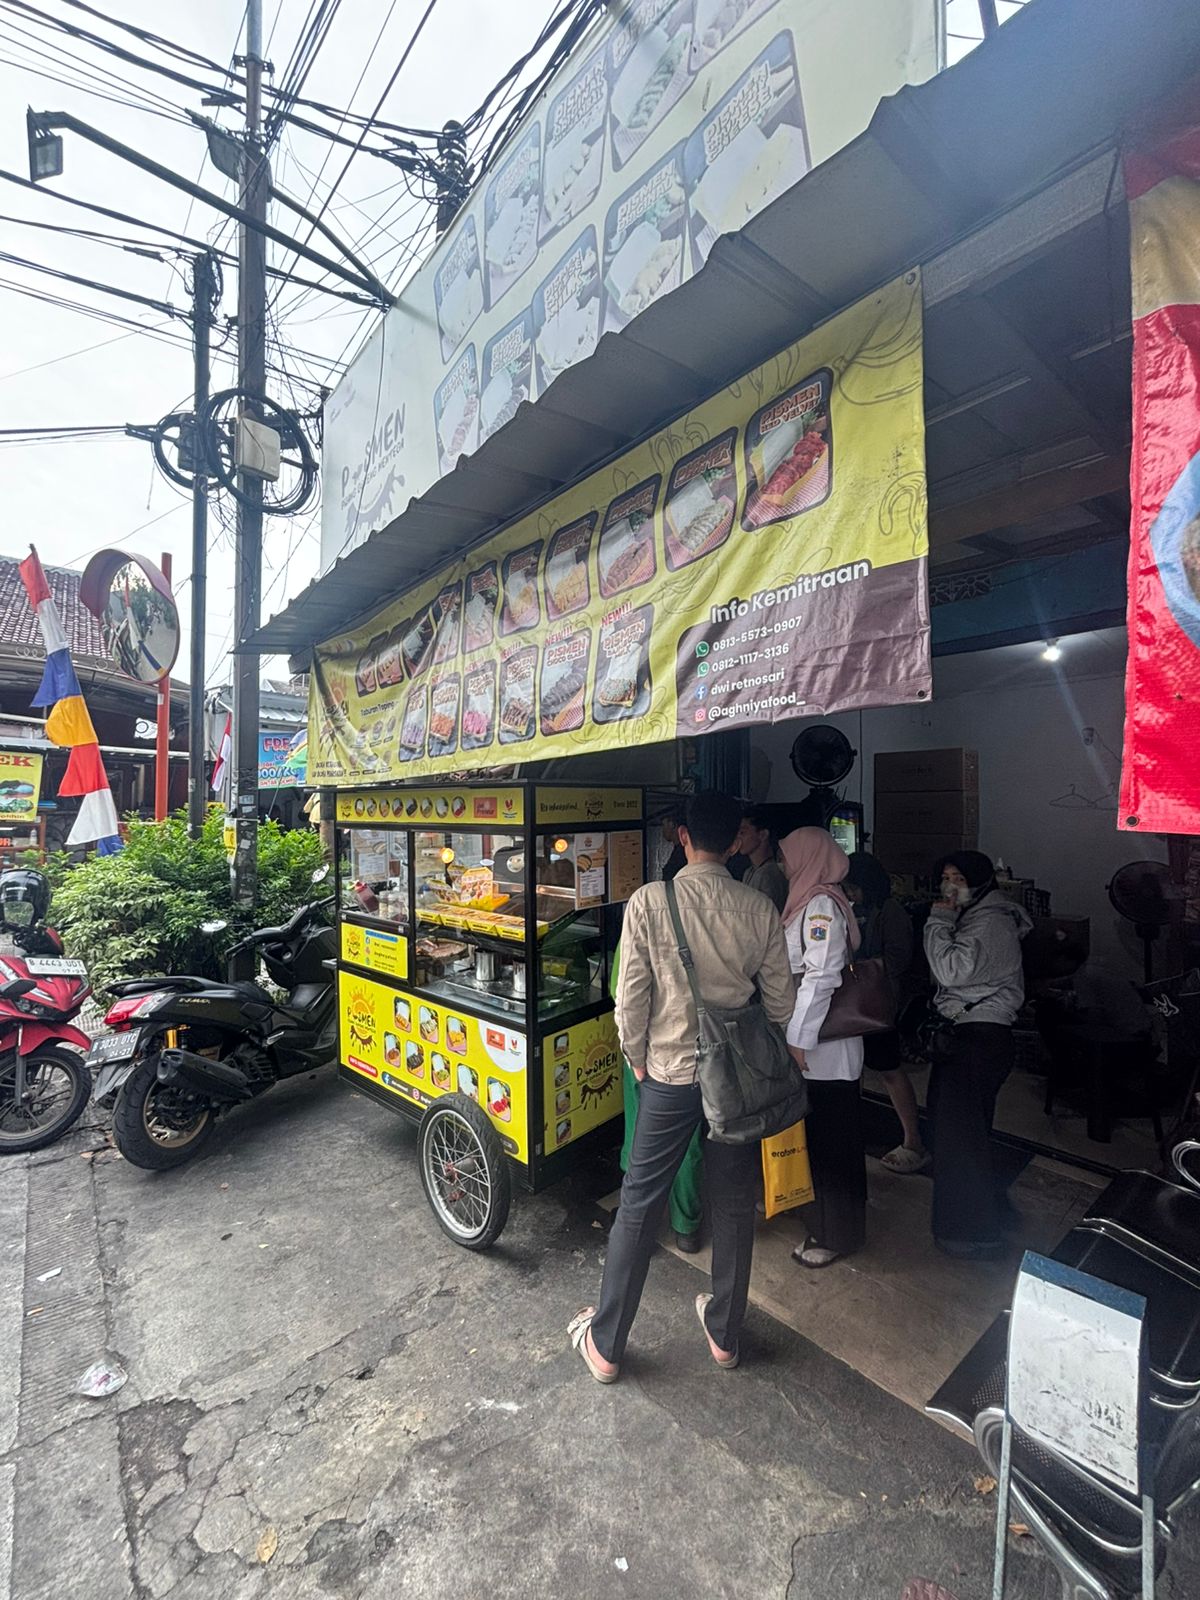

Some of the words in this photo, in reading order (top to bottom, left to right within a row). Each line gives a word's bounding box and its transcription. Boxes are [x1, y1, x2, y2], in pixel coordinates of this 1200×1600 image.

[761, 383, 821, 424] PISMEN
[782, 399, 820, 422] VELVET
[711, 600, 749, 624] Info
[751, 561, 869, 612] Kemitraan
[547, 637, 587, 660] PISMEN
[712, 616, 802, 652] 0813-5573-0907
[712, 643, 790, 672] 0812-1117-3136
[711, 680, 730, 695] dwi
[731, 668, 785, 691] retnosari
[708, 692, 806, 721] @aghniyafood_
